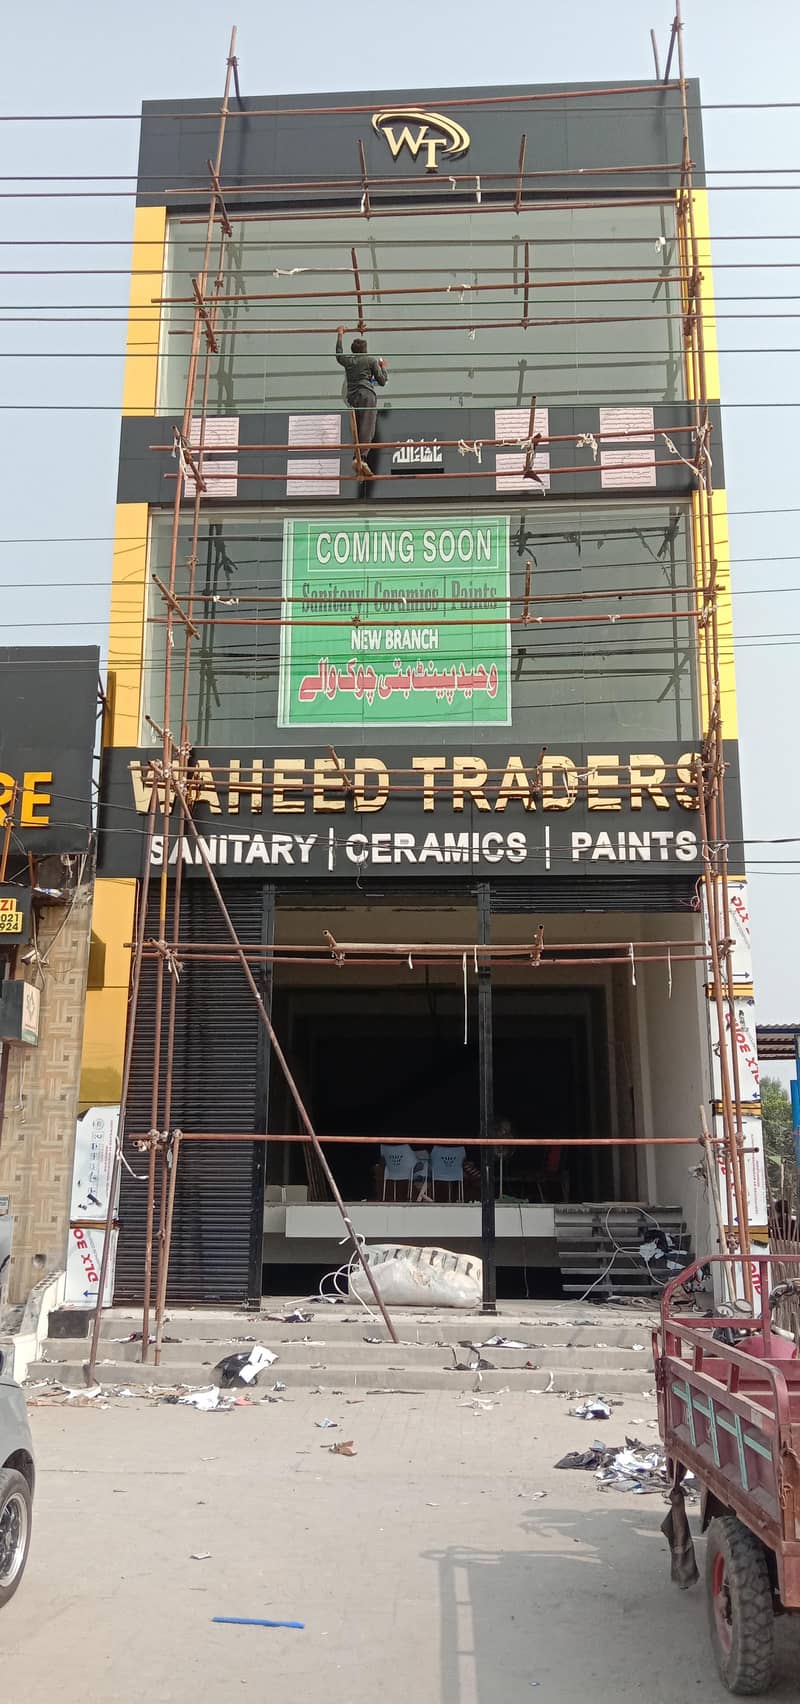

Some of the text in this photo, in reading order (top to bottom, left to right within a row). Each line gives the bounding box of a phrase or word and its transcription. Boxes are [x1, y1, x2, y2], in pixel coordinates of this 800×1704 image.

[382, 126, 447, 168] WT
[316, 528, 492, 564] COMING SOON
[302, 580, 497, 614] Sanitary Ceramics Paints
[351, 628, 439, 650] NEW BRANCH
[130, 752, 703, 814] WAHEED TRADERS
[149, 830, 698, 865] SANITARY CERAMICS PAINTS
[81, 1253, 99, 1283] DLX
